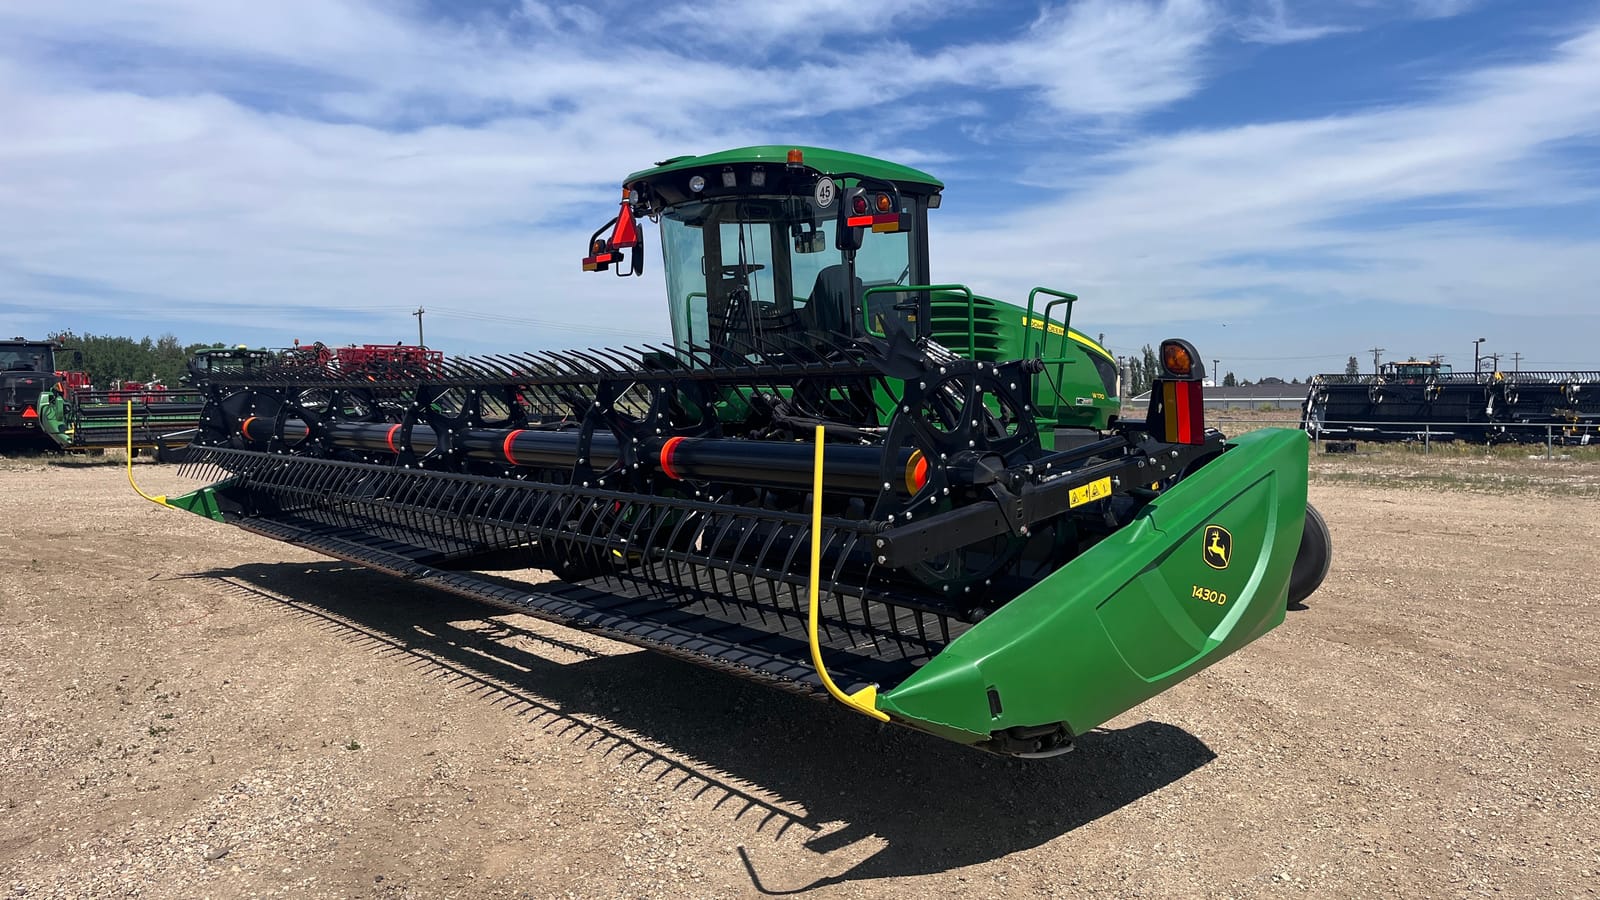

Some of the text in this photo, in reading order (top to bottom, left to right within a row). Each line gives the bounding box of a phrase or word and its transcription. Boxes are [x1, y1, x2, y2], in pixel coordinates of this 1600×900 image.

[820, 186, 830, 199] 45
[1191, 585, 1227, 605] 1430 D
